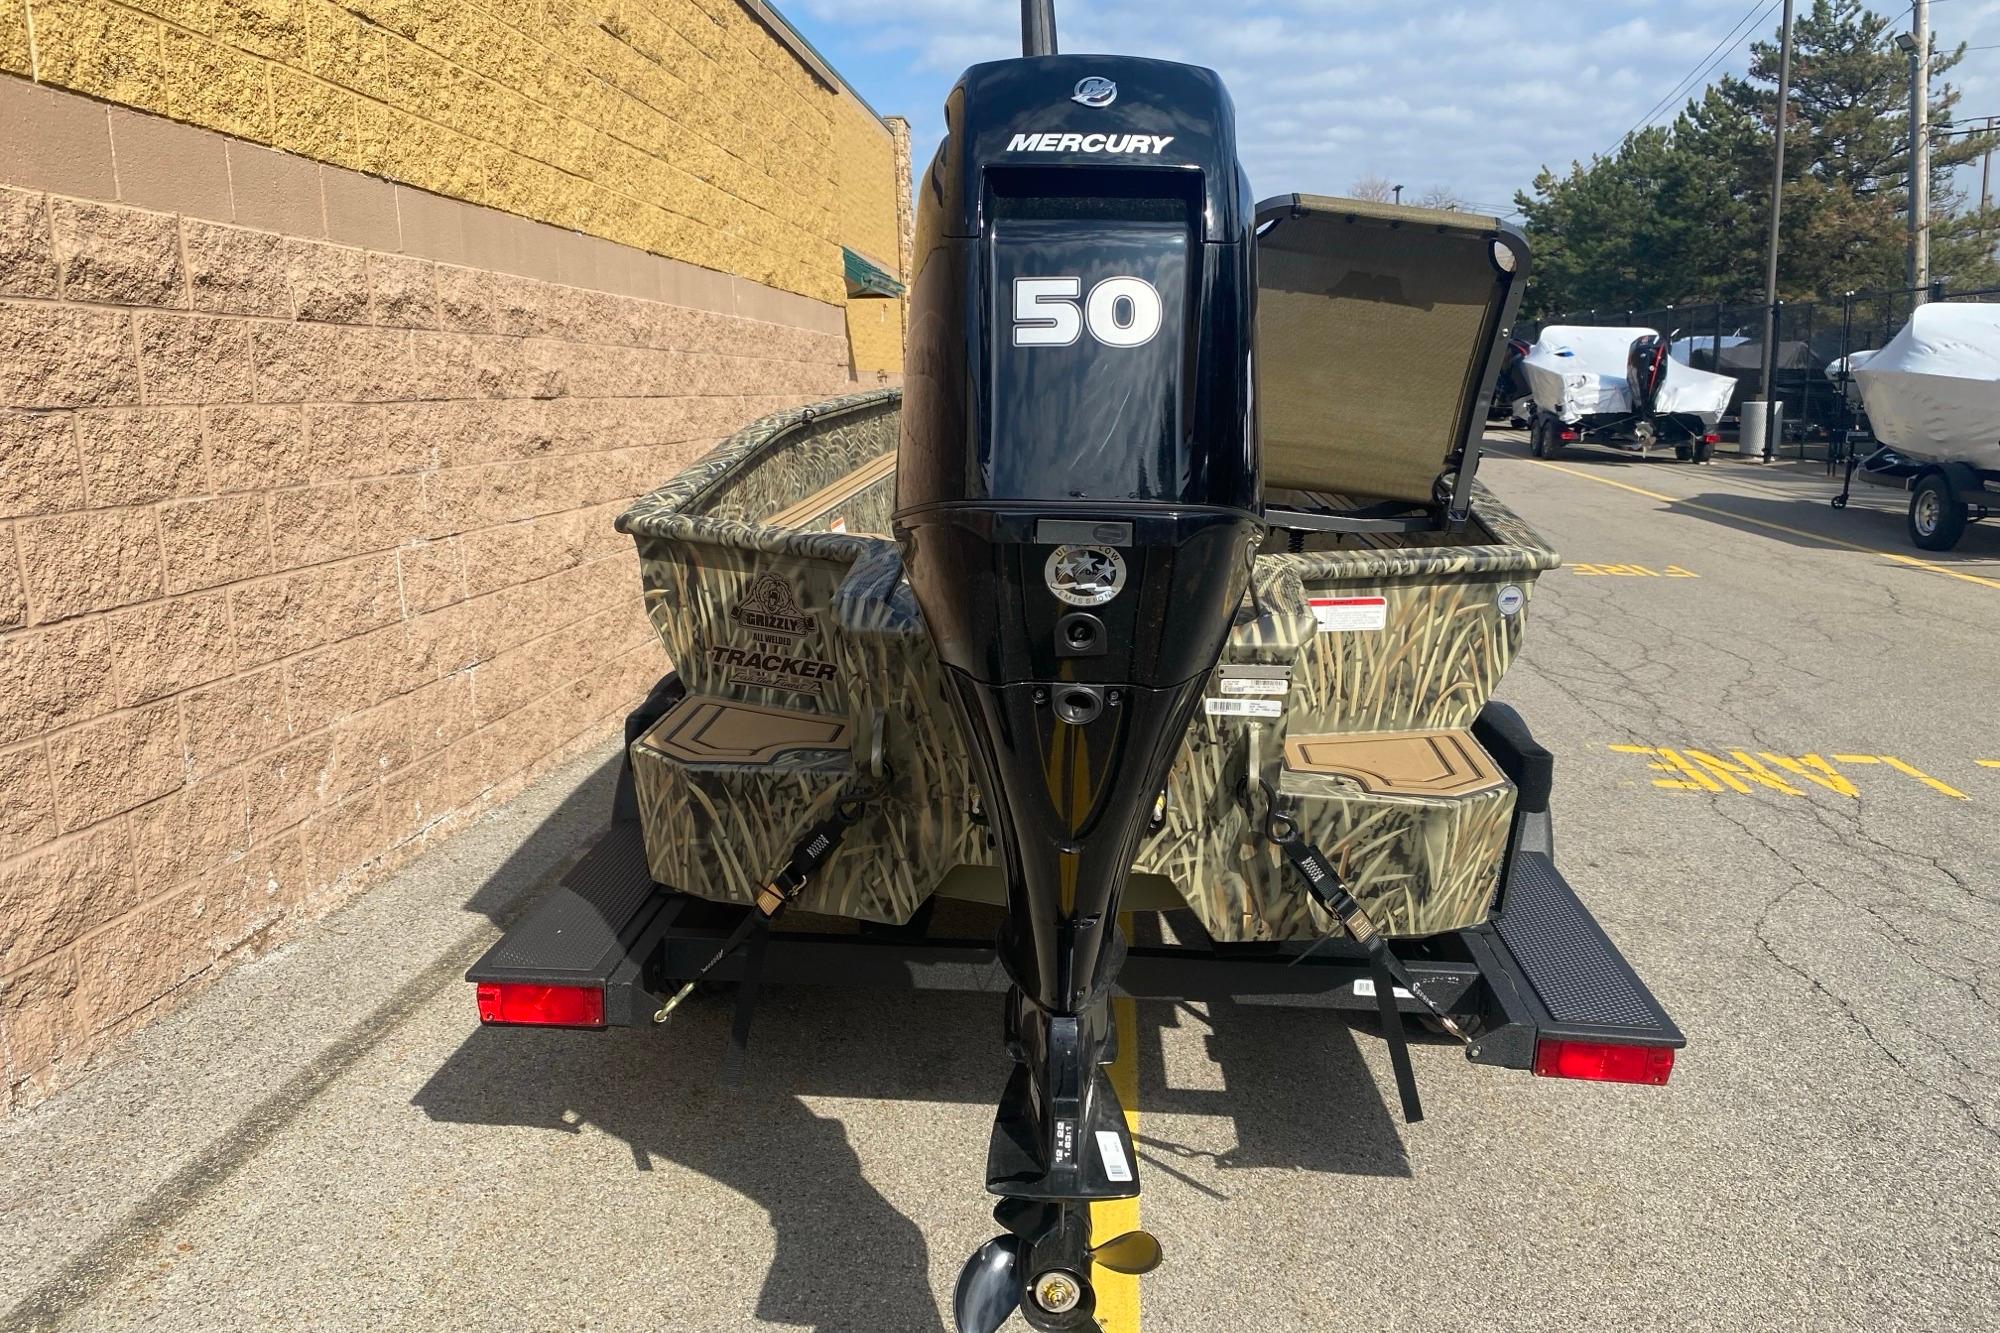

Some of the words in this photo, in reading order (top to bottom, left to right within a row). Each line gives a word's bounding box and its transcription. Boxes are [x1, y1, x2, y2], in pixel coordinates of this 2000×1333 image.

[1006, 133, 1174, 154] MERCURY
[1012, 275, 1163, 348] 50
[746, 612, 798, 632] GRIZZLY
[753, 632, 764, 643] ALL
[765, 633, 792, 646] WELDED
[712, 646, 838, 681] TRACKER
[1607, 744, 1973, 801] LANE
[1056, 1149, 1063, 1162] 12
